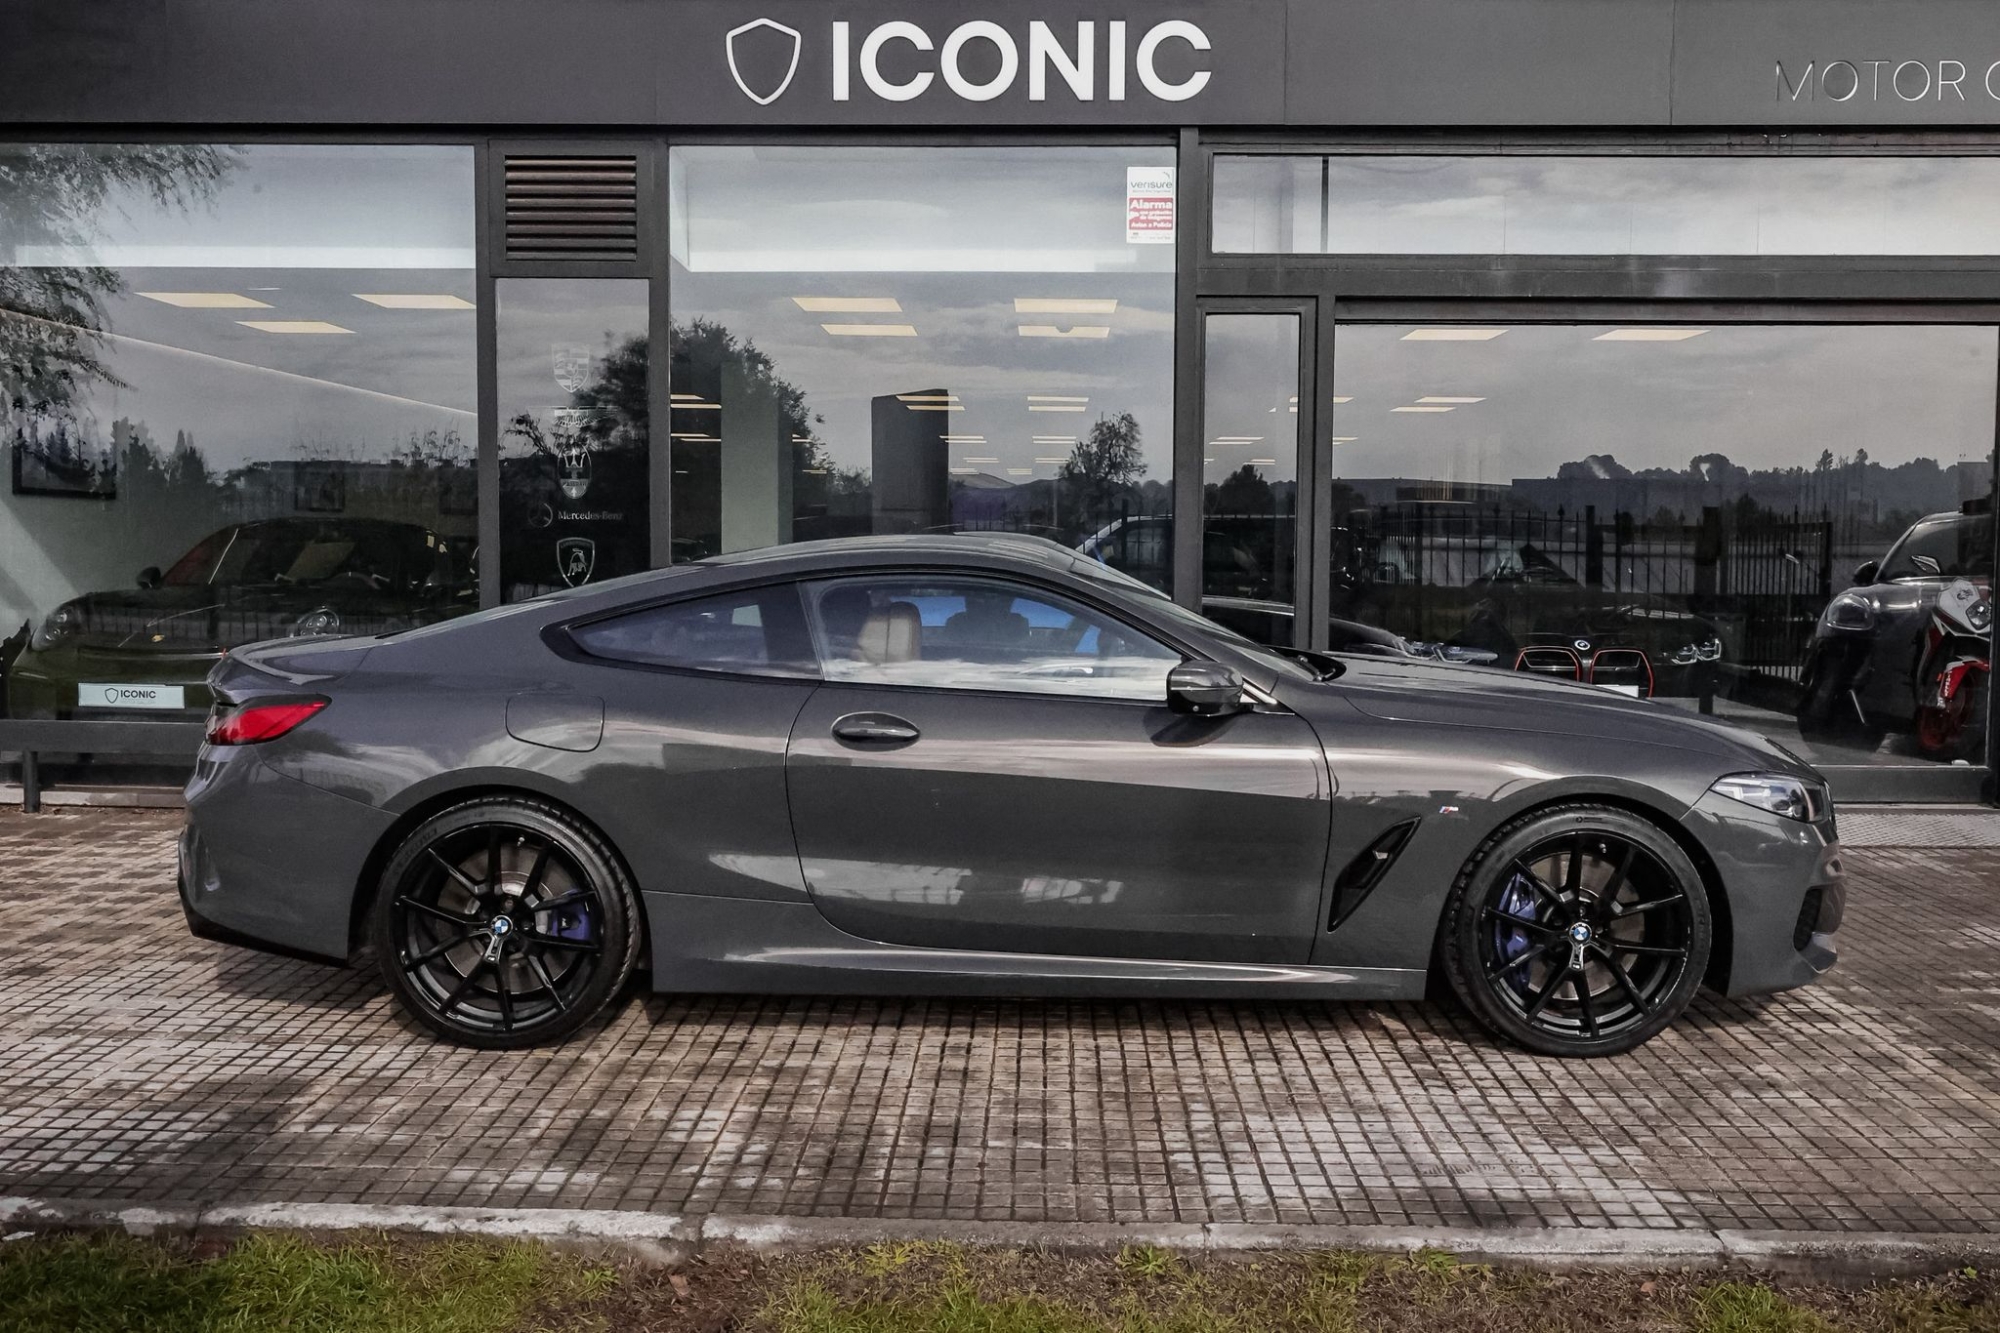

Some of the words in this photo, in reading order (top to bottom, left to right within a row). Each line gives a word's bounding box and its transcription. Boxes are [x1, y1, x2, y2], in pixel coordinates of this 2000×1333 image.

[832, 19, 1213, 102] ICONIC
[1775, 59, 1966, 102] MOTOR
[1130, 180, 1173, 189] verisure
[1130, 199, 1173, 210] Alarma
[557, 510, 624, 520] Mercedes-Benz
[120, 689, 157, 699] ICONIC
